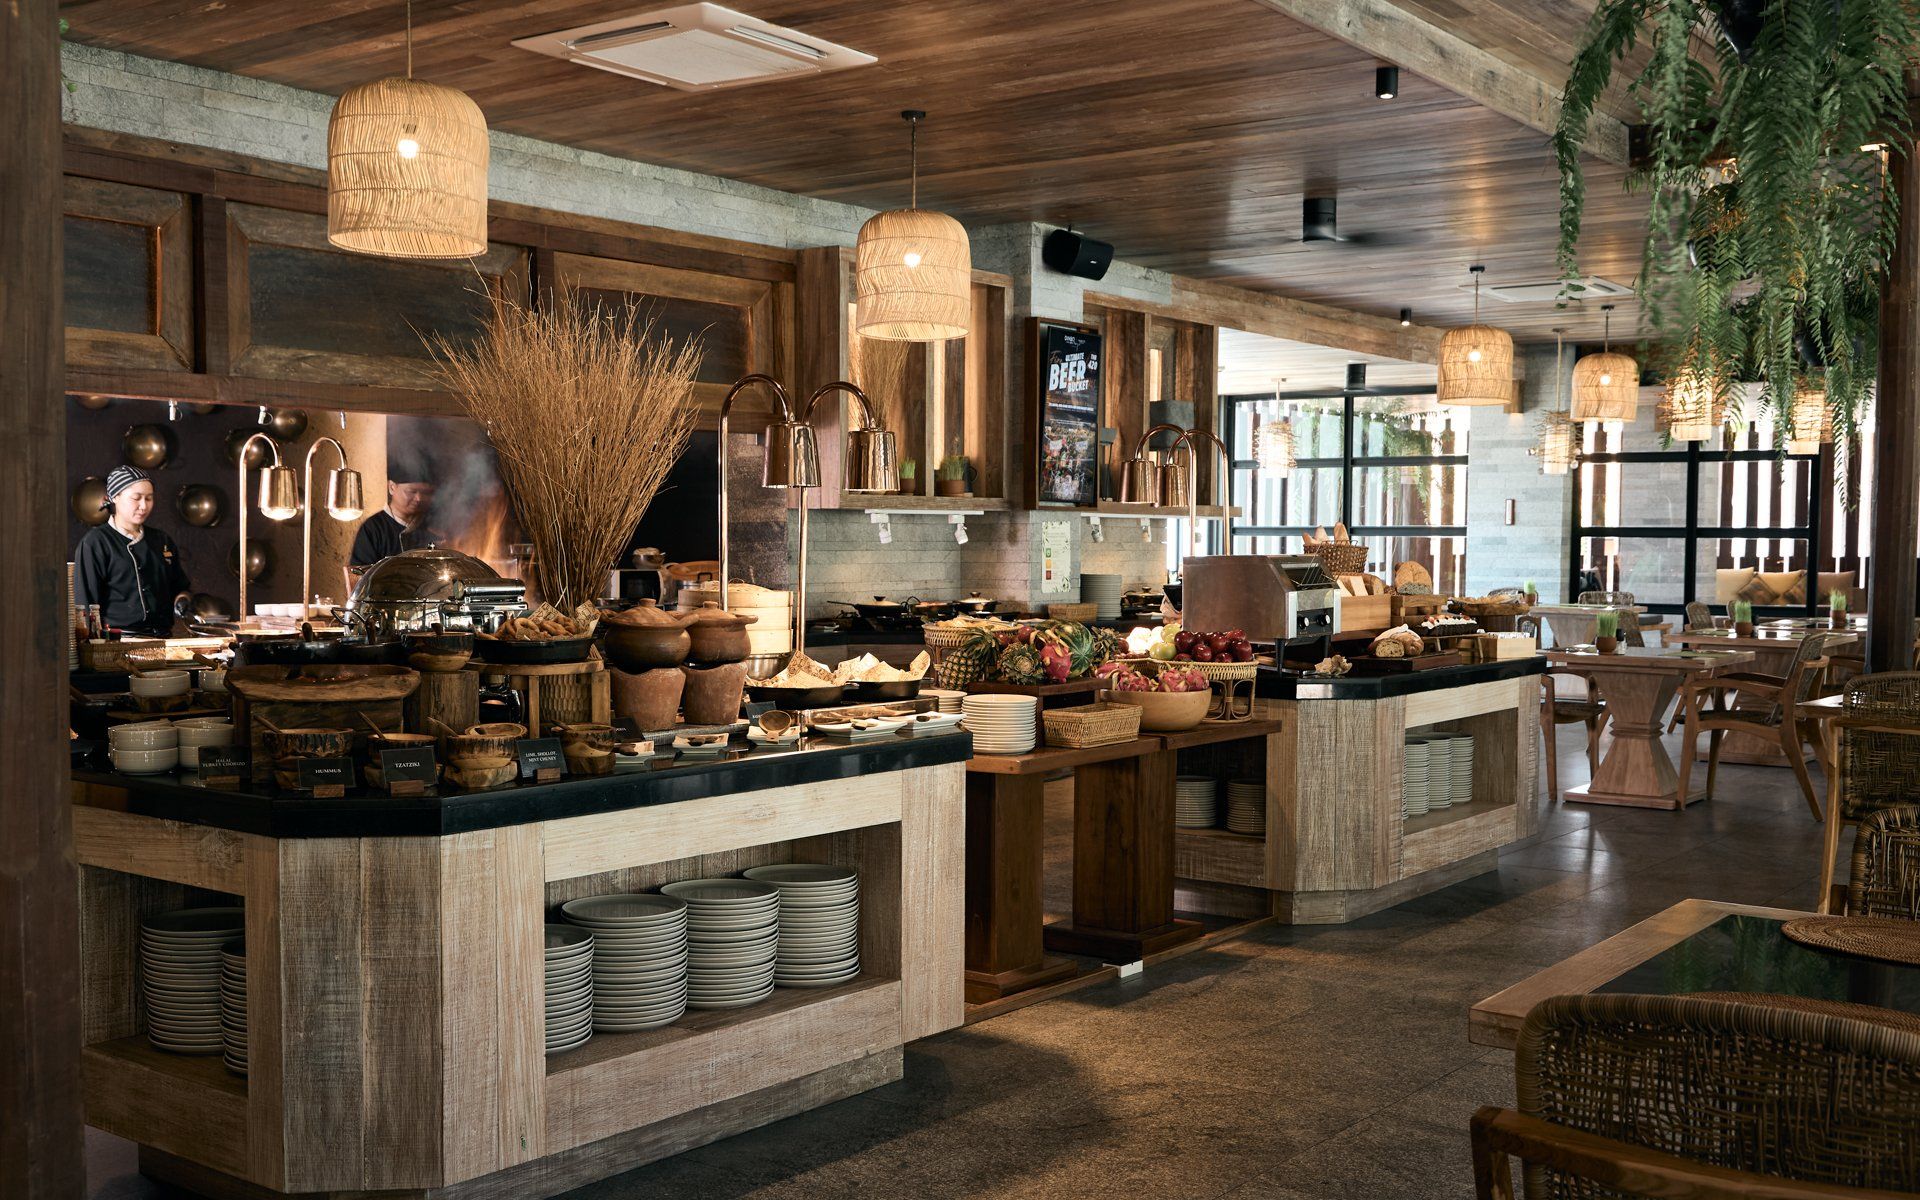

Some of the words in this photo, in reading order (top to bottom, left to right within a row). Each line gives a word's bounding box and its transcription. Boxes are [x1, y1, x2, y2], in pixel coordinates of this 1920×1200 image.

[1087, 360, 1098, 370] 420
[1049, 360, 1086, 390] BEER
[1068, 380, 1089, 392] BUCKET
